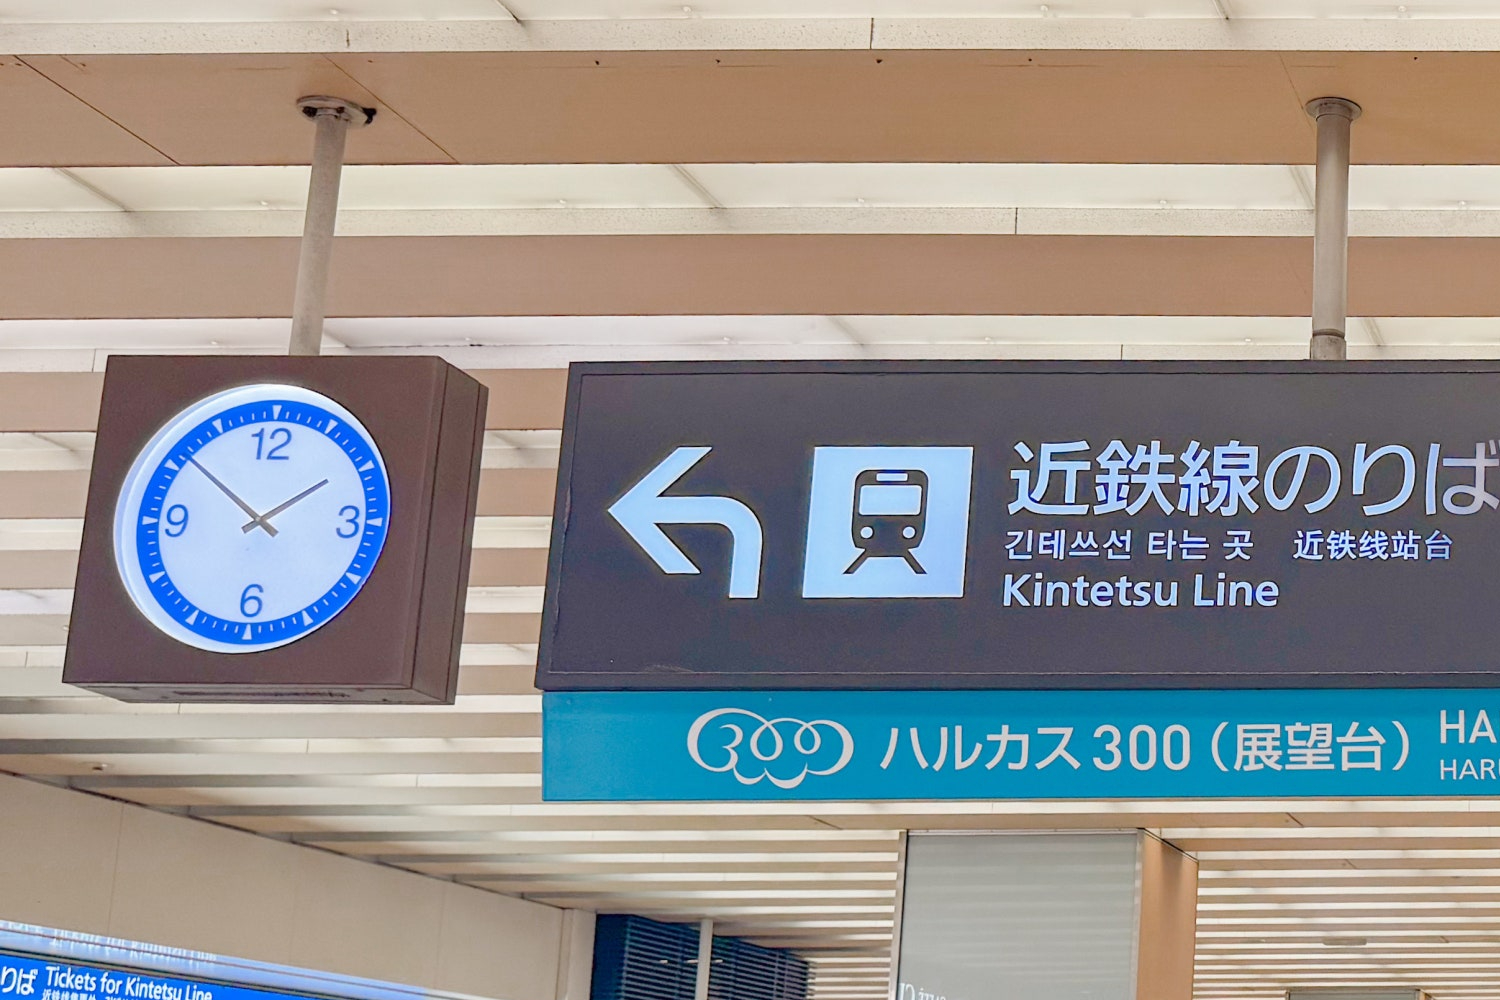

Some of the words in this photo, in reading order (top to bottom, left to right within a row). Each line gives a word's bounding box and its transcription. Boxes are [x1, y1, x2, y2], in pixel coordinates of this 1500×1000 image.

[250, 428, 291, 461] 12
[165, 504, 188, 537] 9
[336, 506, 360, 539] 3
[1004, 529, 1133, 561] 긴테쓰선
[1148, 530, 1210, 560] 타는
[1223, 530, 1255, 561] 곳
[1293, 529, 1453, 561] 近铁线站台
[240, 584, 263, 618] 6
[1002, 573, 1178, 607] Kintetsu
[1193, 573, 1279, 607] Line
[45, 966, 97, 993] Tickets
[100, 974, 121, 995] for
